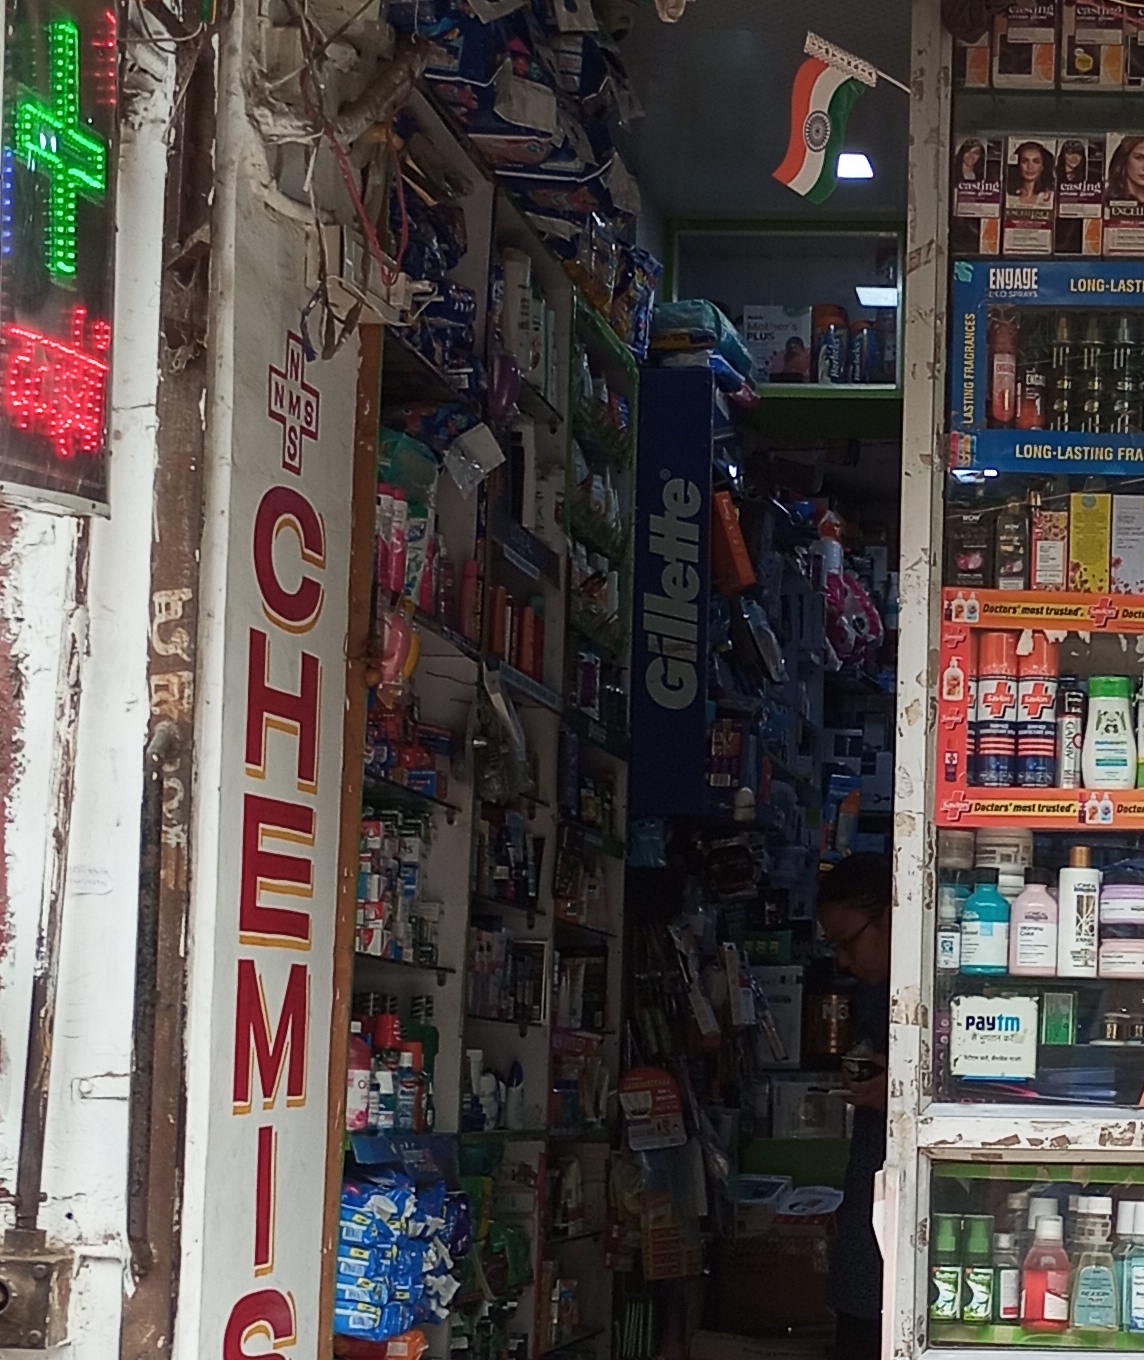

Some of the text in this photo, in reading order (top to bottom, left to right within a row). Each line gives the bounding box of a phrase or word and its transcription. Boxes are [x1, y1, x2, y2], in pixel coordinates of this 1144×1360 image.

[1015, 443, 1114, 462] LONG-LASTING
[644, 475, 701, 711] Gillette
[1021, 606, 1046, 616] most
[1012, 804, 1036, 814] most
[965, 1013, 1021, 1032] paytm
